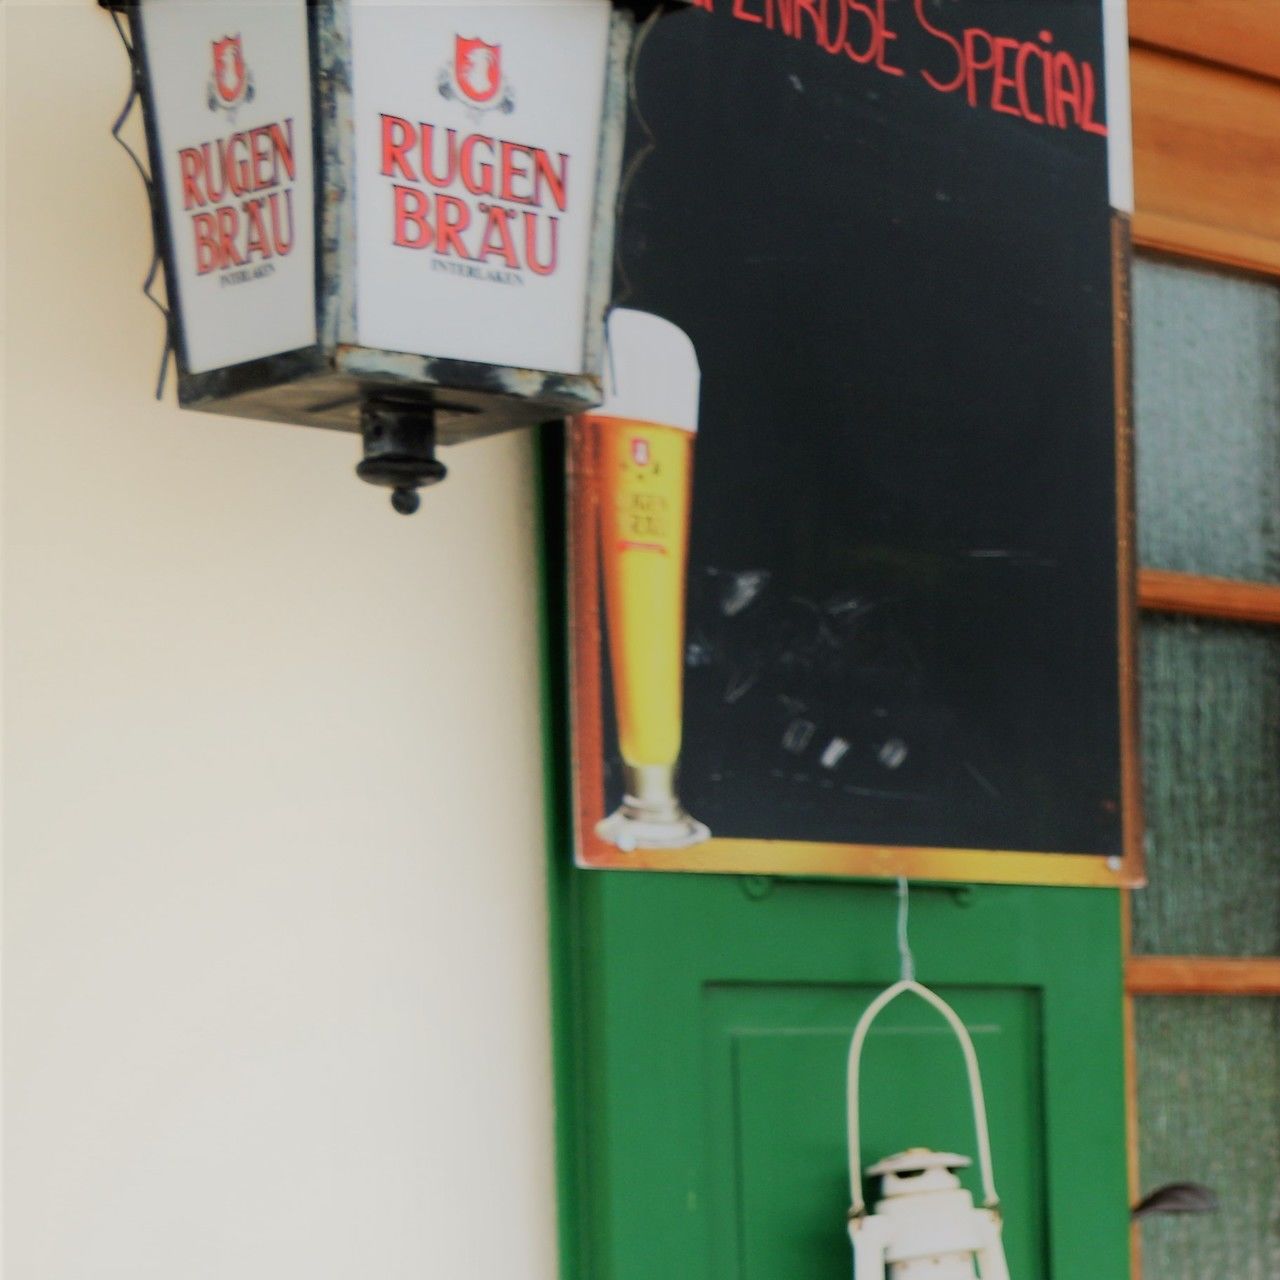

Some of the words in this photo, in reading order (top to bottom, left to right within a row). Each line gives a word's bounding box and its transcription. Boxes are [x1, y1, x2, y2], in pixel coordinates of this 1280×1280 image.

[178, 118, 295, 211] RUGEN
[379, 112, 569, 213] RUGEN
[191, 188, 295, 276] BRÄU
[392, 184, 559, 277] BRÄU
